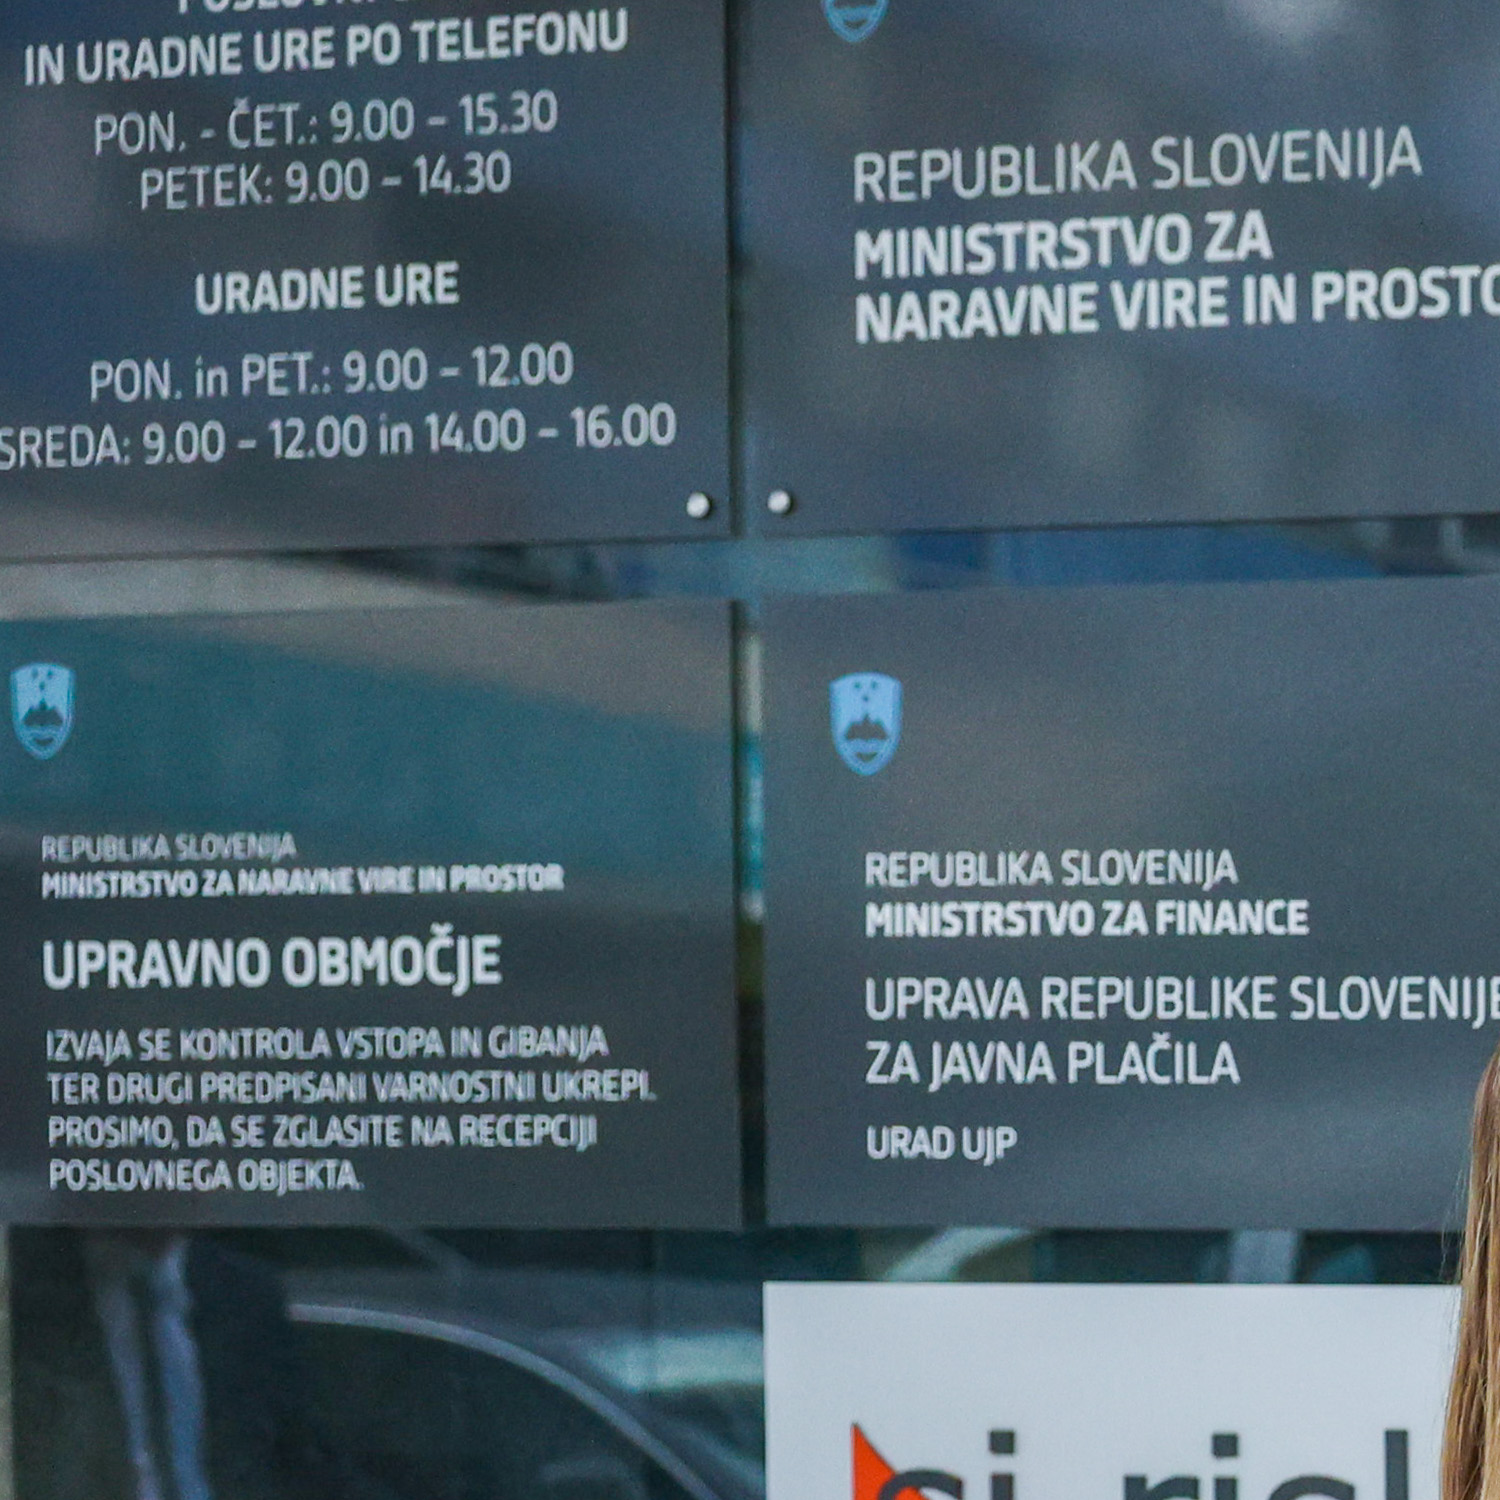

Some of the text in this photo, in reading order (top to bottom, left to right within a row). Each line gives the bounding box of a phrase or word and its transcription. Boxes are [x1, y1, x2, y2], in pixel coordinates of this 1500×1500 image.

[25, 8, 627, 85] IN URADNE URE PO TELEFONU
[95, 111, 185, 155] PON.
[330, 98, 414, 143] 9.00
[459, 90, 557, 135] 15.30
[141, 164, 272, 210] PETEK:
[286, 158, 369, 203] 9.00
[415, 150, 511, 194] 14.30
[854, 126, 1422, 202] REPUBLIKA SLOVENIJA
[855, 210, 1272, 279] MINISTRSTVO ZA
[196, 261, 459, 315] URADNE URE
[856, 285, 1098, 343] NARAVNE
[1112, 278, 1228, 330] VIRE
[1244, 274, 1296, 324] IN
[91, 359, 181, 402] PON.
[196, 356, 228, 397] in
[242, 352, 330, 395] PET.:
[343, 348, 428, 393] 9.00
[472, 342, 573, 387] 12.00
[0, 424, 130, 469] SREDA:
[143, 420, 225, 464] 9.00
[269, 415, 367, 459] 12.00
[380, 414, 413, 454] in
[425, 409, 526, 452] 14.00
[571, 403, 676, 448] 16.00
[42, 832, 296, 862] REPUBLIKA SLOVENIJA
[866, 849, 1238, 890] REPUBLIKA SLOVENIJA
[42, 864, 564, 898] MINISTRSTVO ZA NARAVNE VIRE IN PROSTOR
[866, 899, 1309, 937] MINISTRSTVO ZA FINANCE
[44, 922, 502, 997] UPRAVNO OBMOČJE
[866, 977, 1029, 1020] UPRAVA
[1042, 976, 1277, 1019] REPUBLIKE
[47, 1025, 609, 1065] IZVAJA SE KONTROLA VSTOPA IN GIBANJA
[866, 1033, 1240, 1092] ZA JAVNA PLAČILA
[47, 1069, 656, 1104] TER DRUGI PREDPISANI VARNOSTNI UKREPI.
[48, 1115, 597, 1151] PROSIMO, DA SE ZGLASITE NA RECEPCIJI
[867, 1126, 1017, 1166] URAD UJP
[50, 1159, 362, 1196] POSLOVNEGA OBJEKTA.
